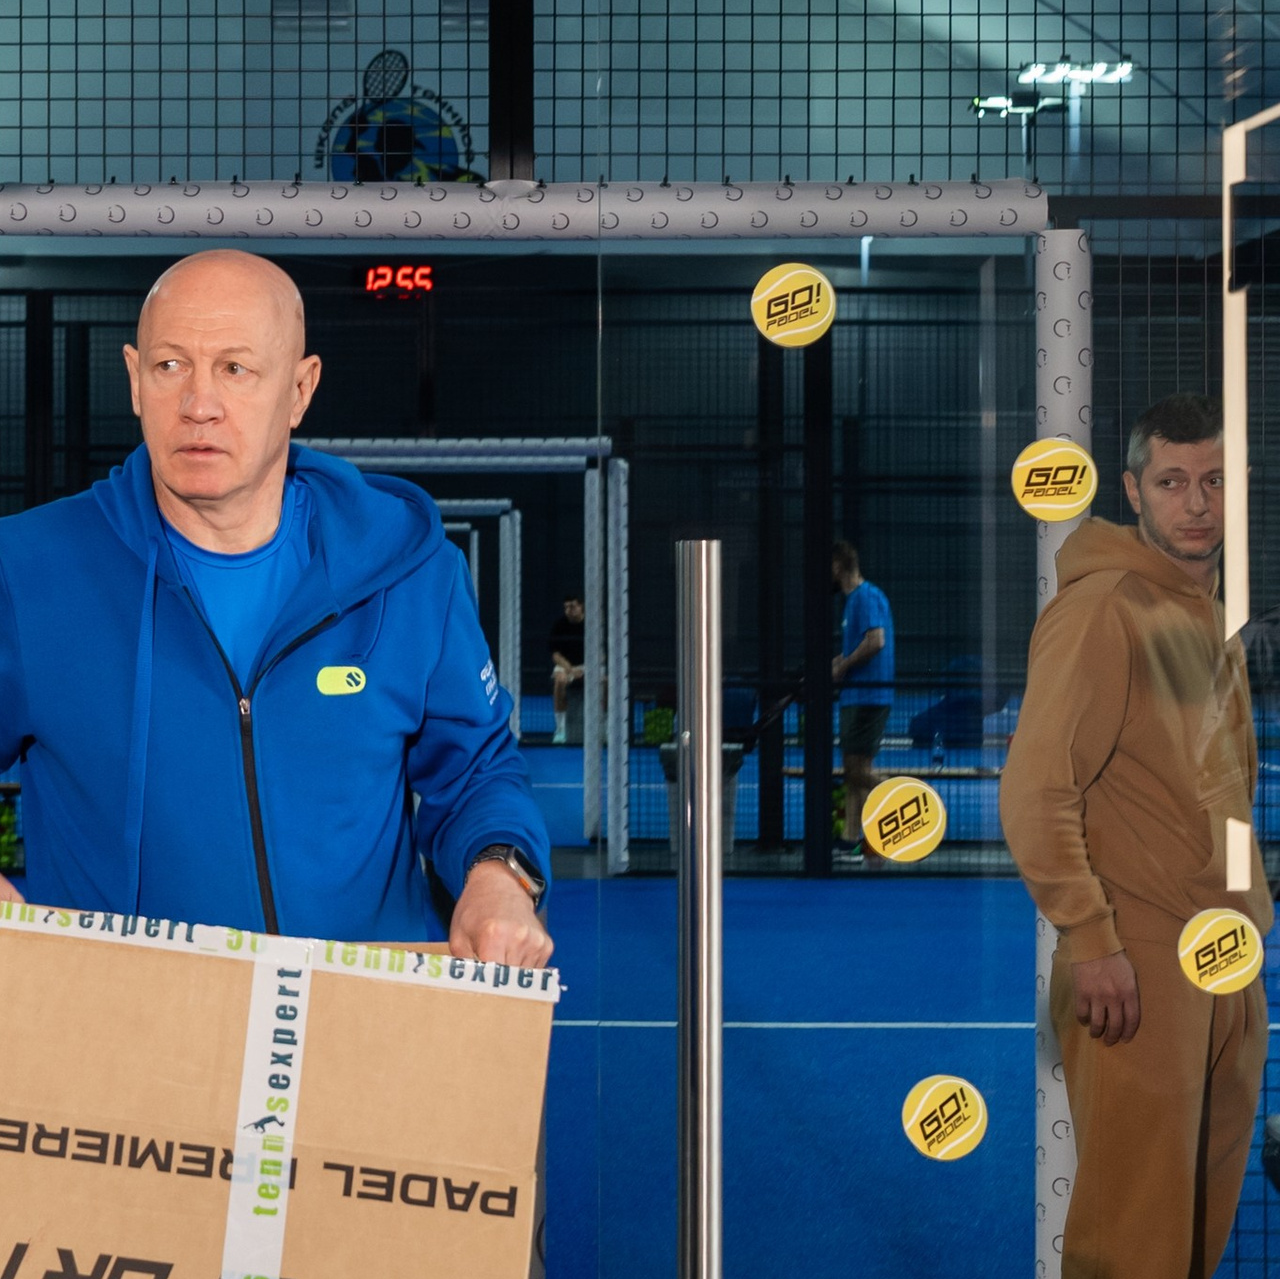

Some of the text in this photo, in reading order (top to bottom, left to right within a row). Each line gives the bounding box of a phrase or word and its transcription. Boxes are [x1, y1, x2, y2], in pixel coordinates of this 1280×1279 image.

[766, 282, 822, 320] GO!
[1025, 465, 1087, 487] GO!
[878, 792, 929, 840] GO!
[1195, 924, 1247, 971] GO!
[919, 1087, 968, 1141] GO!
[323, 1162, 518, 1218] PADEL
